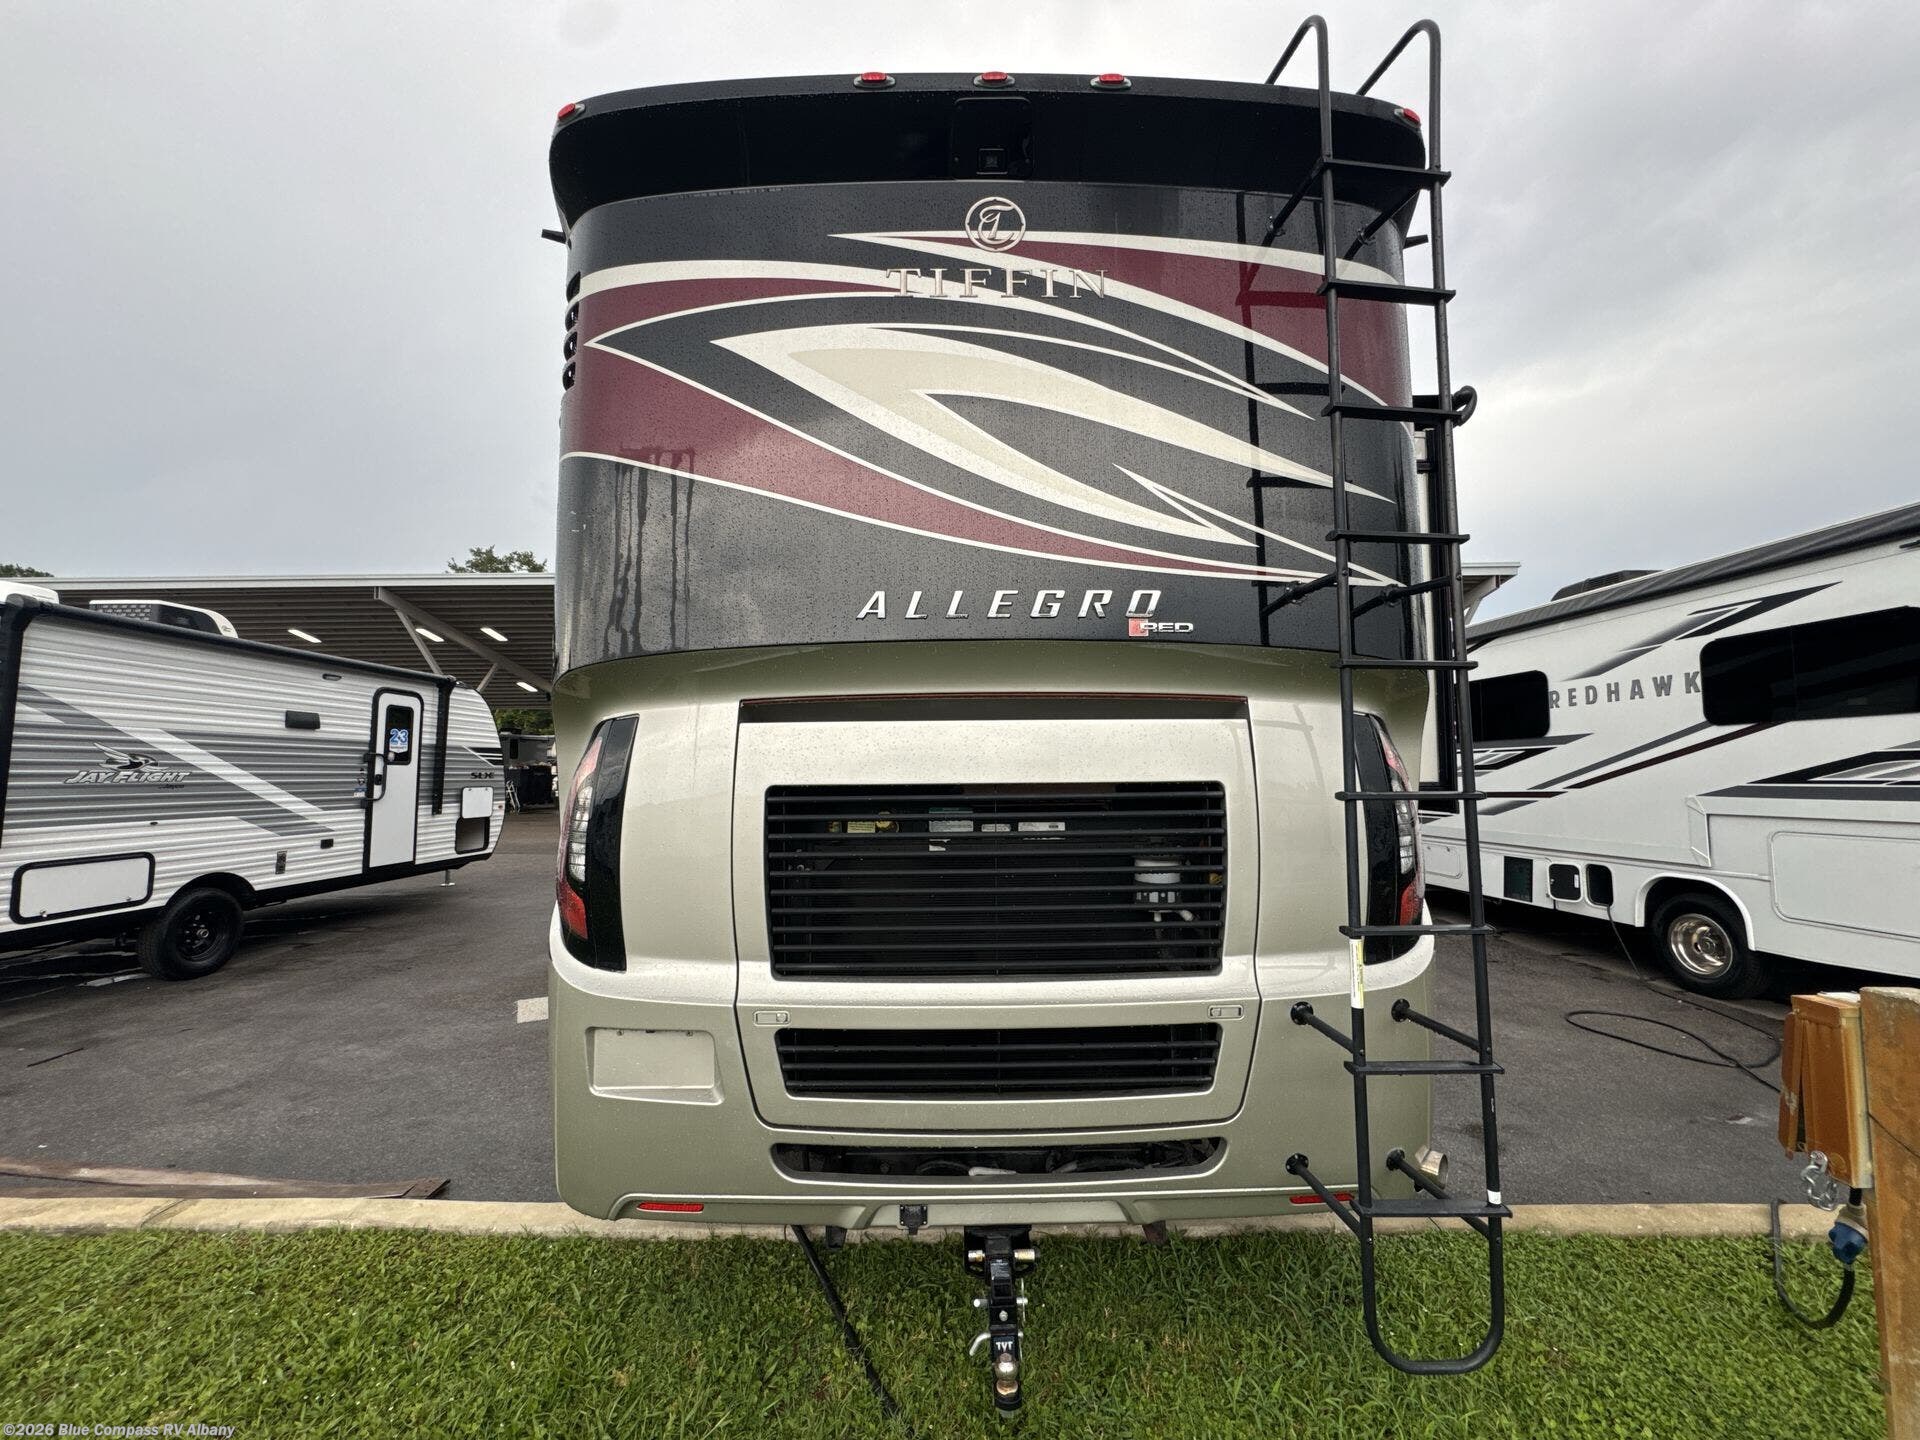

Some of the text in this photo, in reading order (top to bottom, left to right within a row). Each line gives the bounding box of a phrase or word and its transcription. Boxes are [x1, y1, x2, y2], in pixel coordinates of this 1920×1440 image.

[886, 268, 1108, 298] TIFFIN
[855, 590, 1162, 619] ALLEGRO
[1140, 622, 1194, 633] RED
[1549, 671, 1701, 709] REDHAWK
[390, 729, 408, 746] 23
[64, 771, 190, 784] JAY FLIGHT
